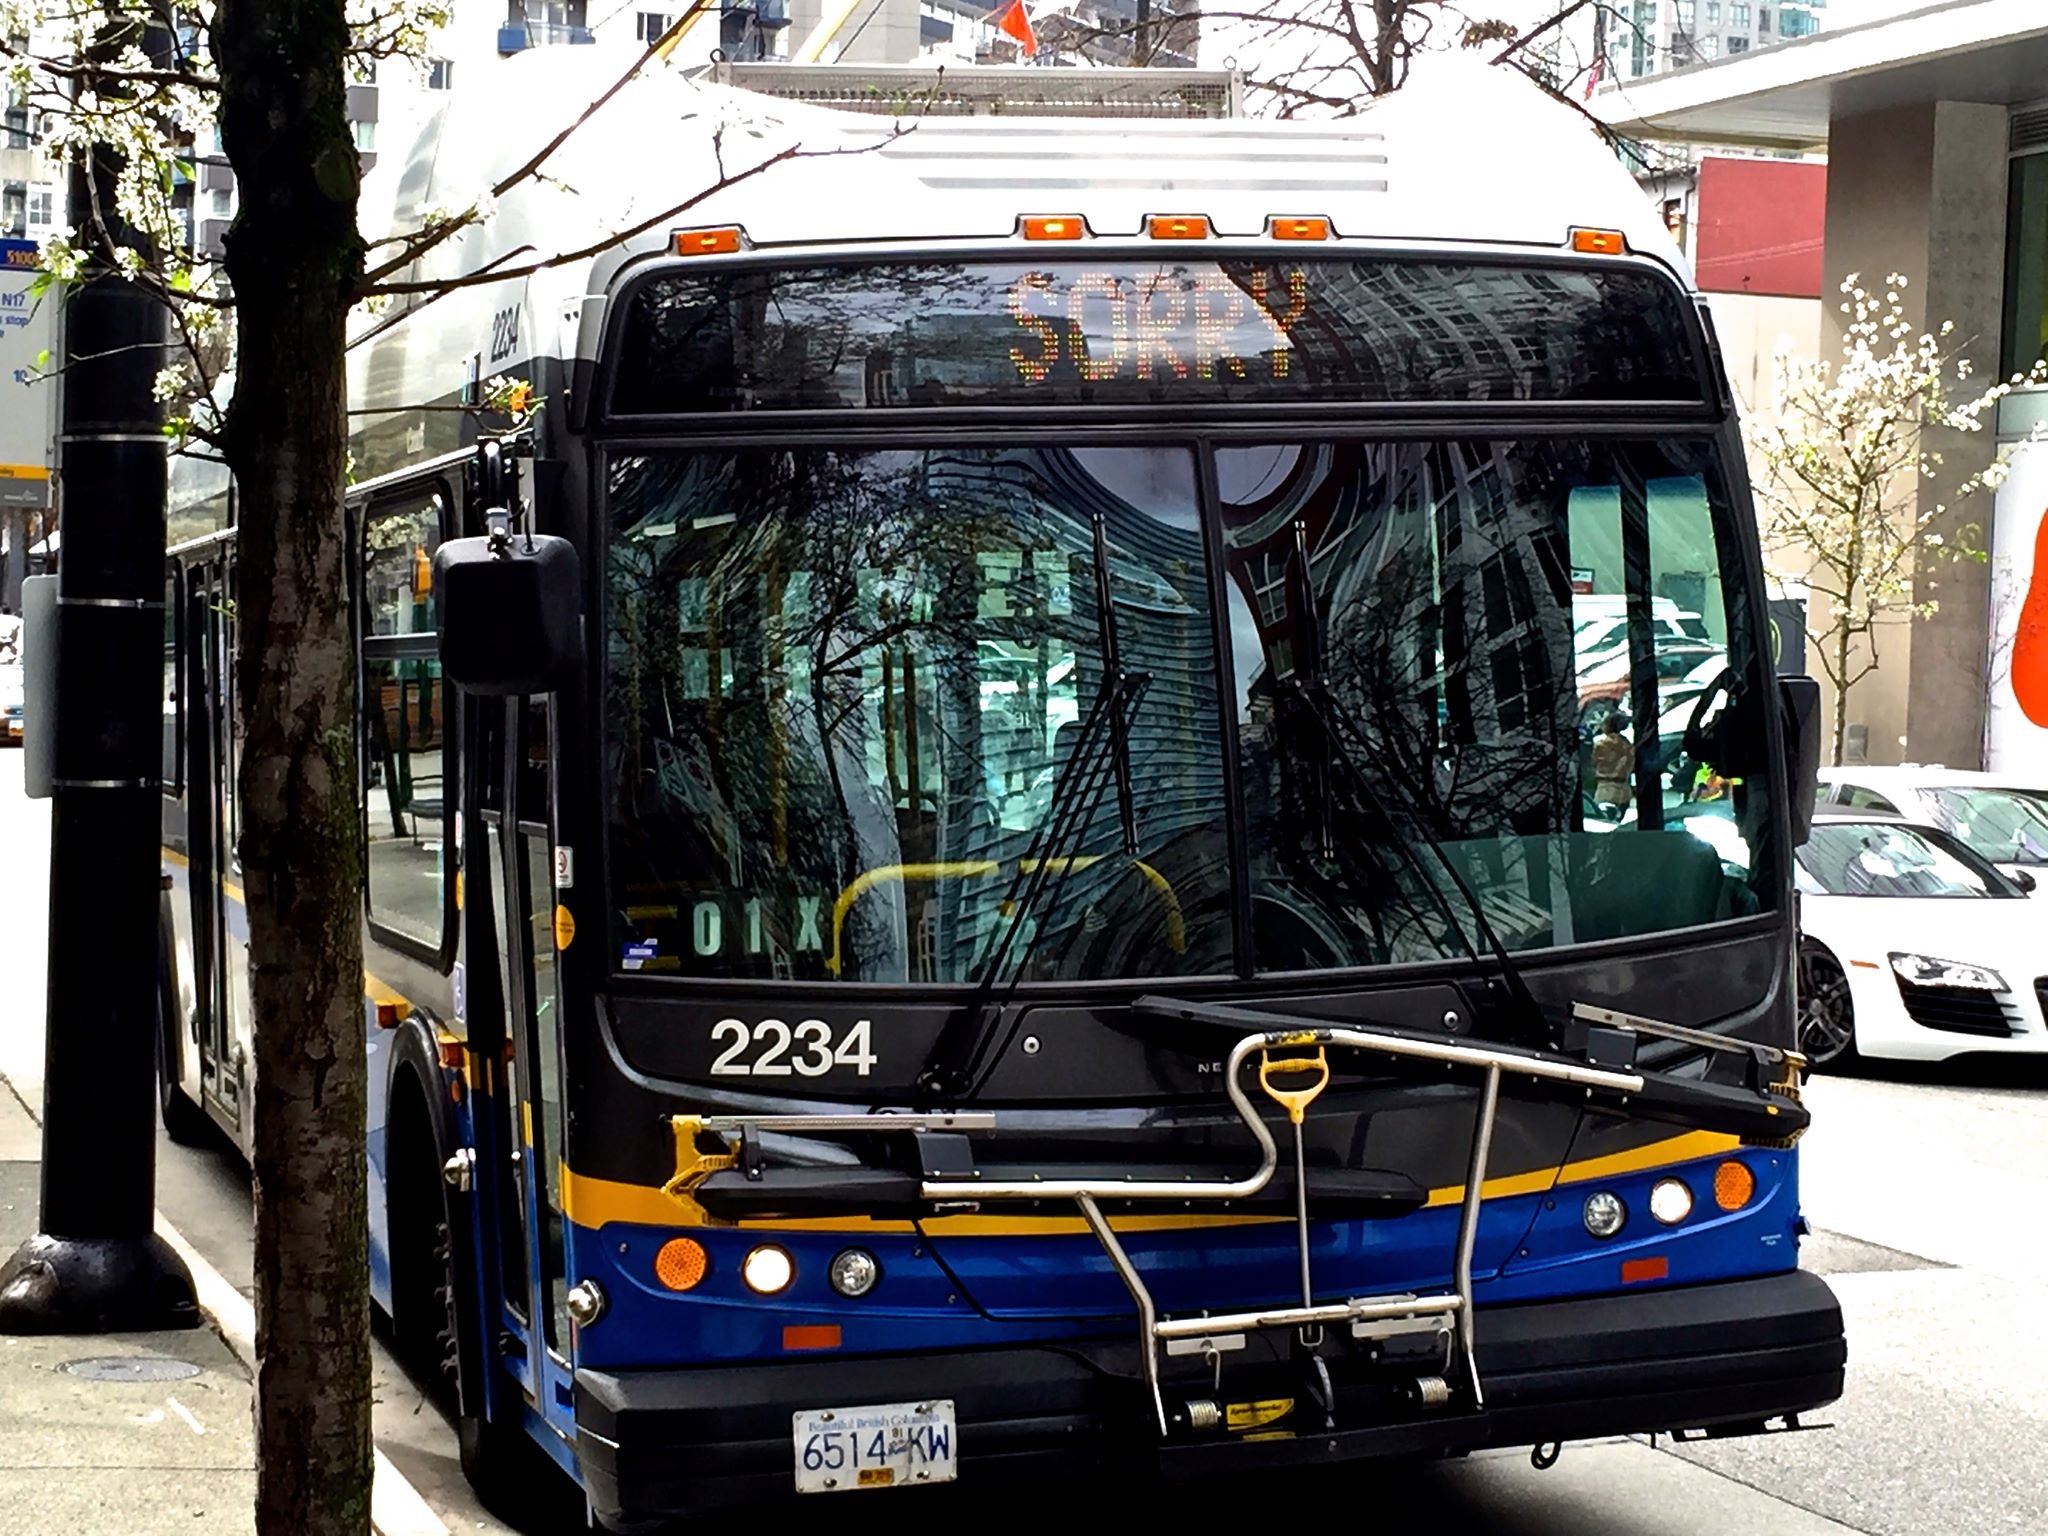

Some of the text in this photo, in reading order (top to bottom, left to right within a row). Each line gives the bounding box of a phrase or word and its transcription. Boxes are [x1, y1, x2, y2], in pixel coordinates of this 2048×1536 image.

[2, 292, 26, 307] N17
[1008, 271, 1306, 381] SORRY
[491, 302, 521, 363] 2234
[710, 1018, 878, 1077] 2234
[803, 1424, 950, 1471] 6514 KW
